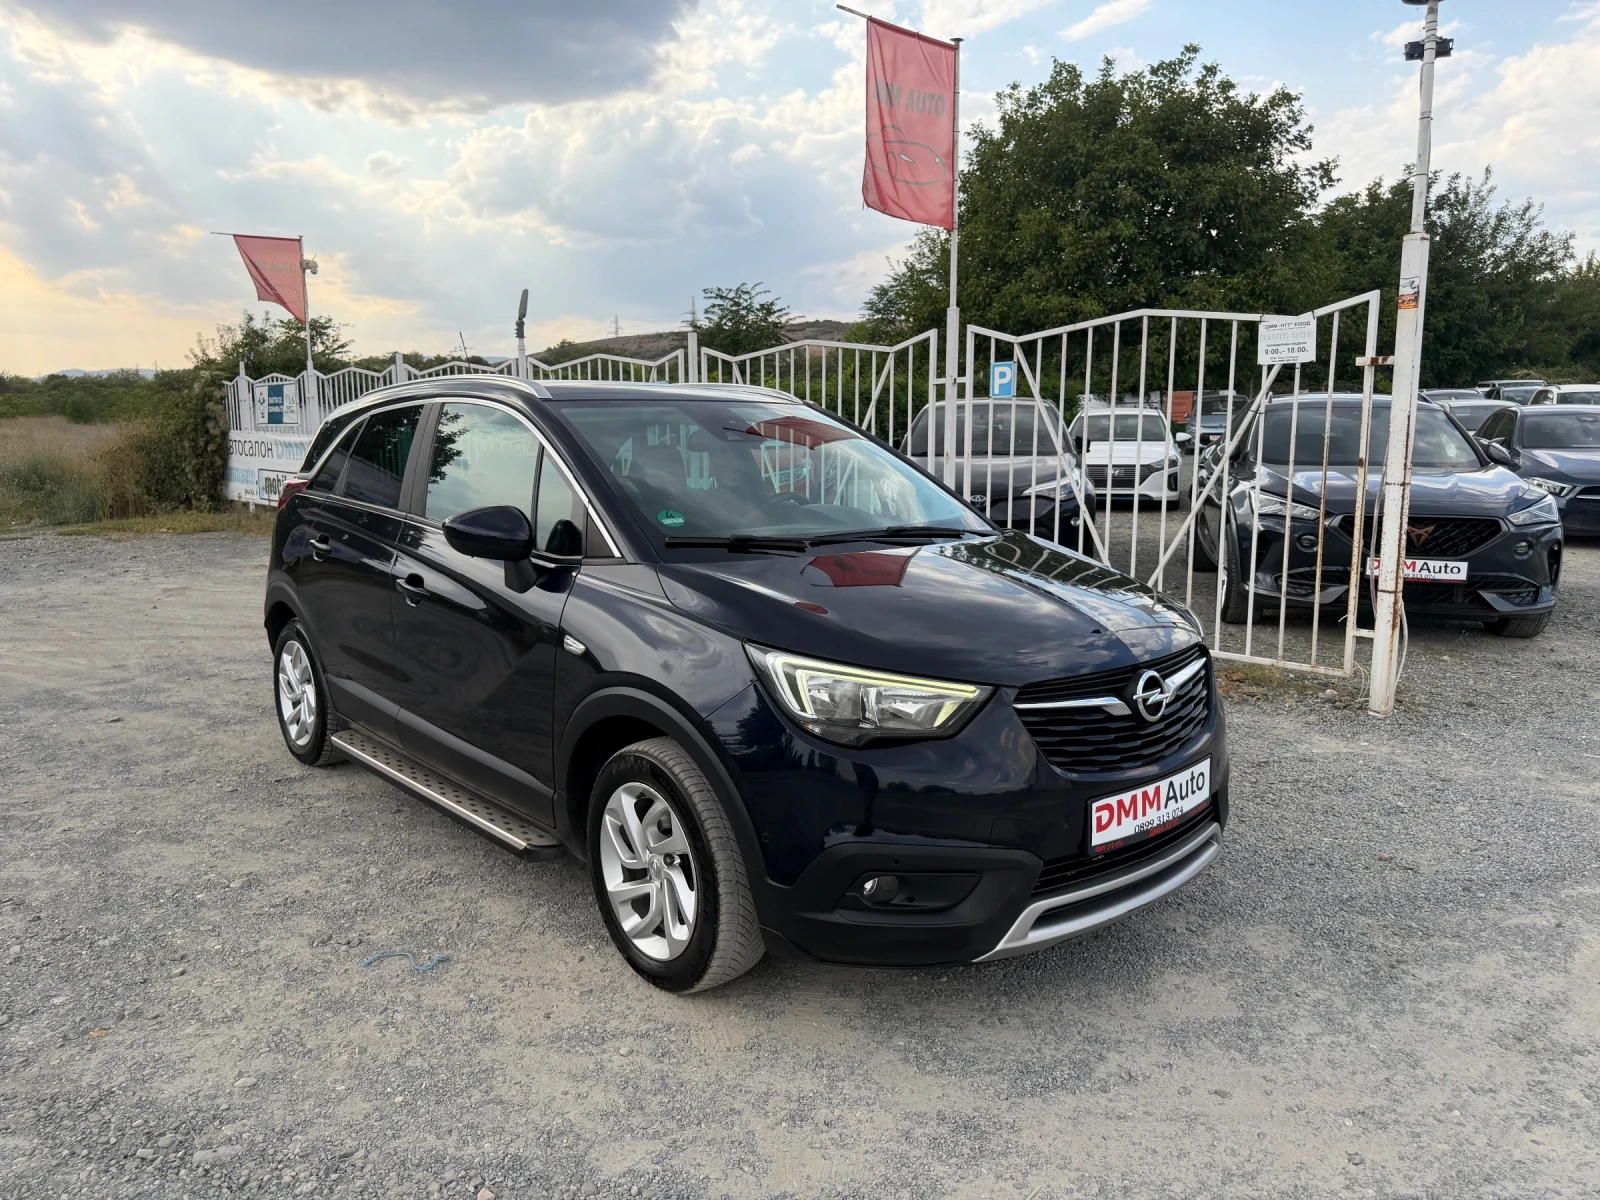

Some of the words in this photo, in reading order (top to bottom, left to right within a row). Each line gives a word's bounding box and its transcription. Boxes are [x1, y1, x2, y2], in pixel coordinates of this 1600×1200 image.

[905, 88, 946, 118] AUTO
[994, 366, 1012, 395] P
[228, 439, 274, 459] втосалон
[1369, 559, 1417, 573] DM
[1418, 561, 1461, 575] Auto
[1095, 785, 1161, 833] DMM
[1164, 771, 1205, 809] Auto
[1134, 819, 1155, 834] 0899
[1156, 812, 1170, 826] 313
[1171, 806, 1184, 819] 074
